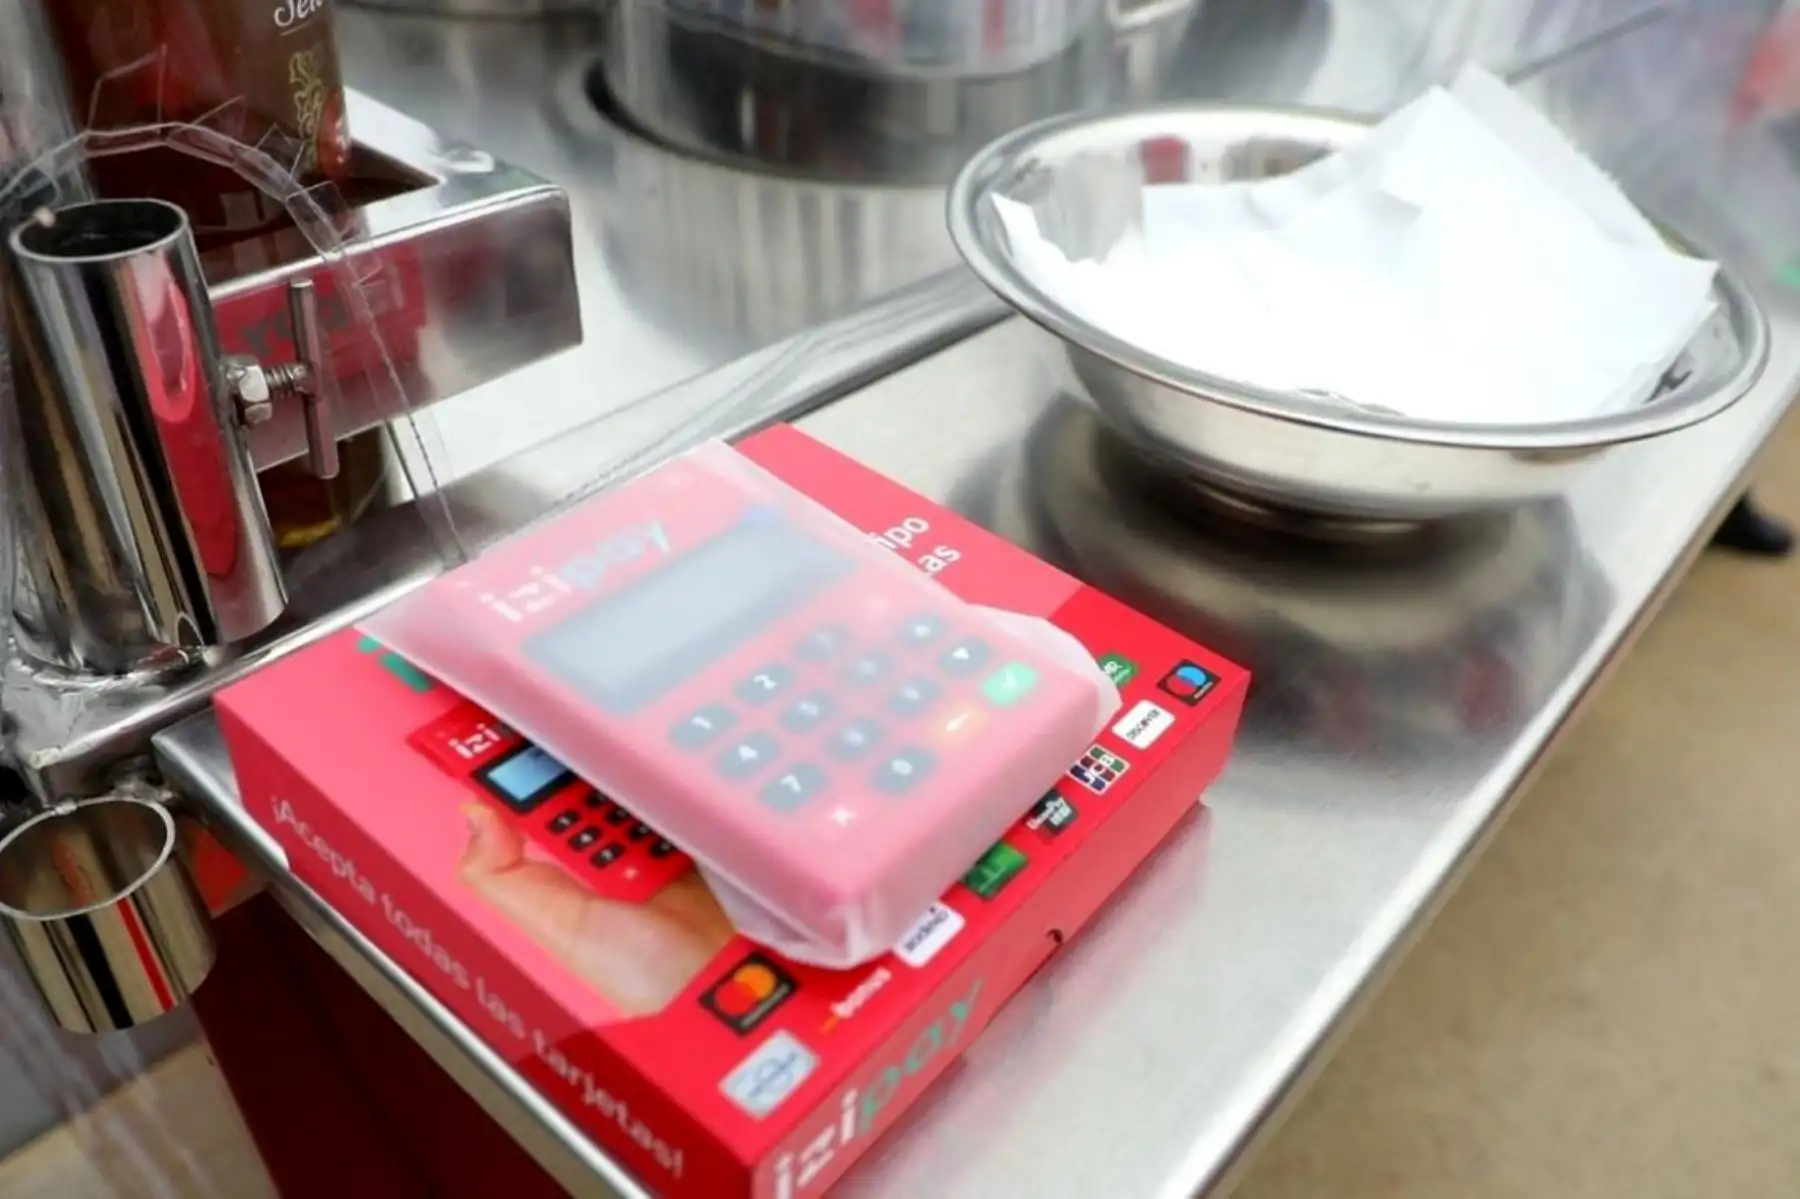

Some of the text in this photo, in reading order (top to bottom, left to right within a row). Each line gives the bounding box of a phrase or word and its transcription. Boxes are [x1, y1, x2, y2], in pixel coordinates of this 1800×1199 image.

[867, 516, 930, 549] ipo
[917, 545, 962, 574] as
[381, 893, 471, 990] todas
[474, 976, 526, 1040] las
